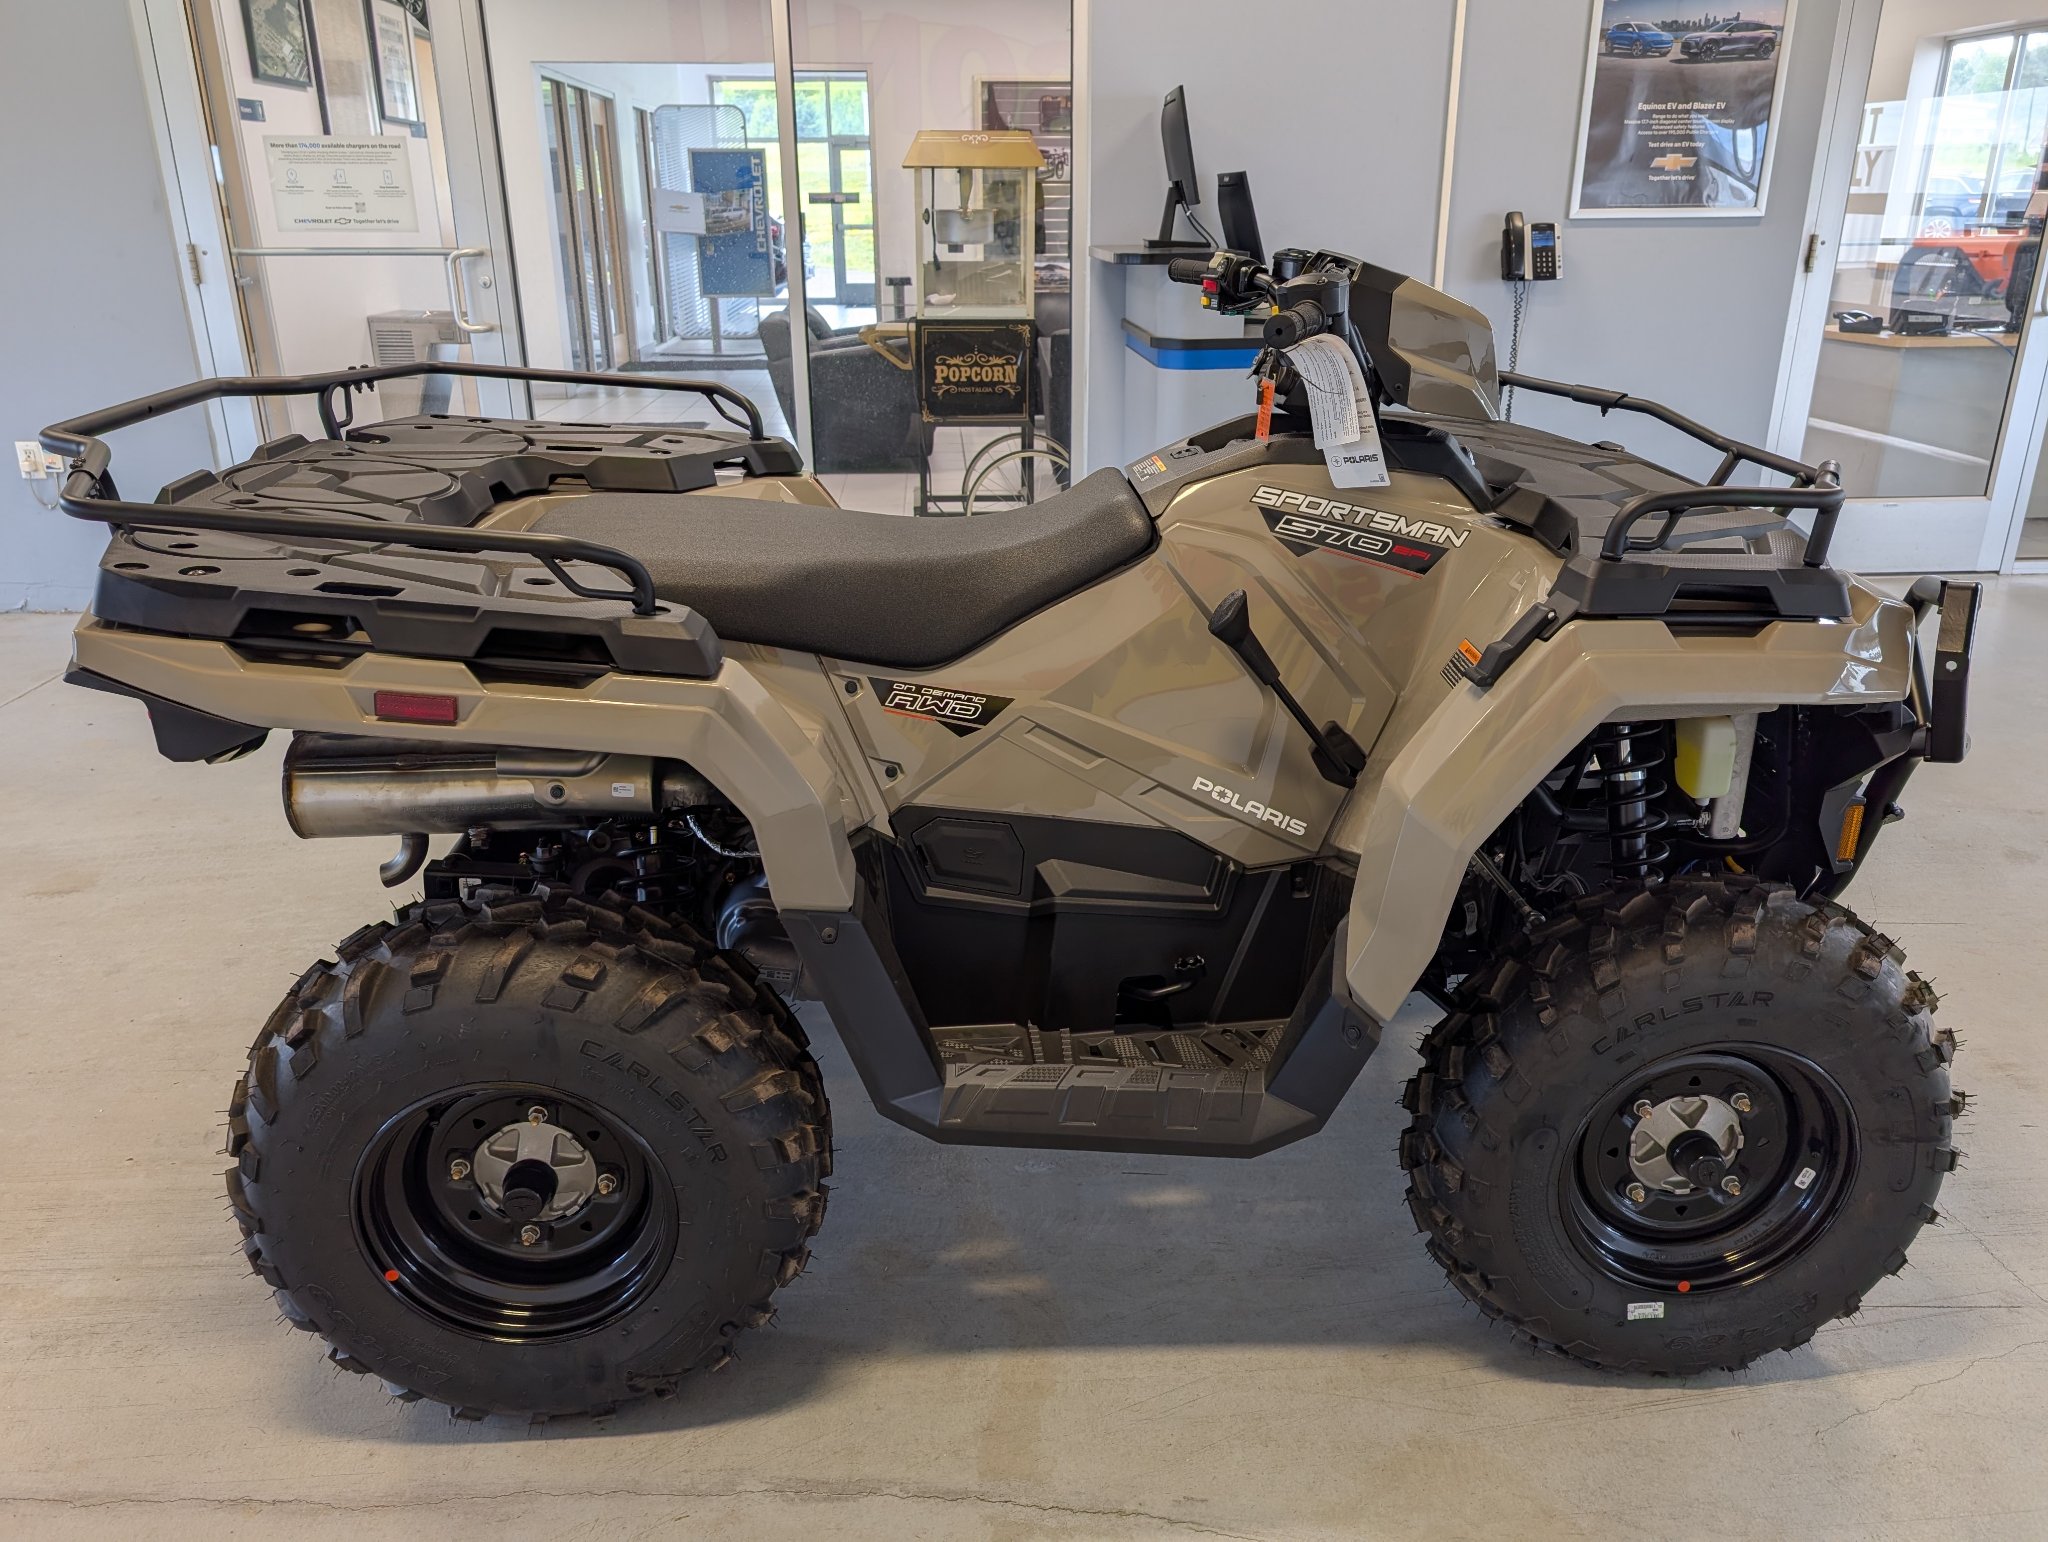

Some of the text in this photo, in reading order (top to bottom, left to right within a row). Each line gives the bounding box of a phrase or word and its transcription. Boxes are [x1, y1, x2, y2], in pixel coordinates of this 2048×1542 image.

[1638, 102, 1666, 111] Equinox
[1678, 102, 1692, 110] and
[1693, 102, 1715, 110] Blazer
[1716, 102, 1726, 110] EV
[751, 156, 767, 252] CHEVROLET
[934, 365, 1019, 384] POPCORN
[1343, 454, 1379, 464] POLARIS
[1250, 485, 1471, 548] SPORTSMAN
[1274, 515, 1431, 561] 570 EFI
[885, 690, 982, 719] AWD
[893, 683, 986, 704] ON DEMAND
[1192, 776, 1308, 836] POLARIS
[1591, 991, 1775, 1056] CARLSTAR
[580, 1039, 728, 1163] CARLSTAR
